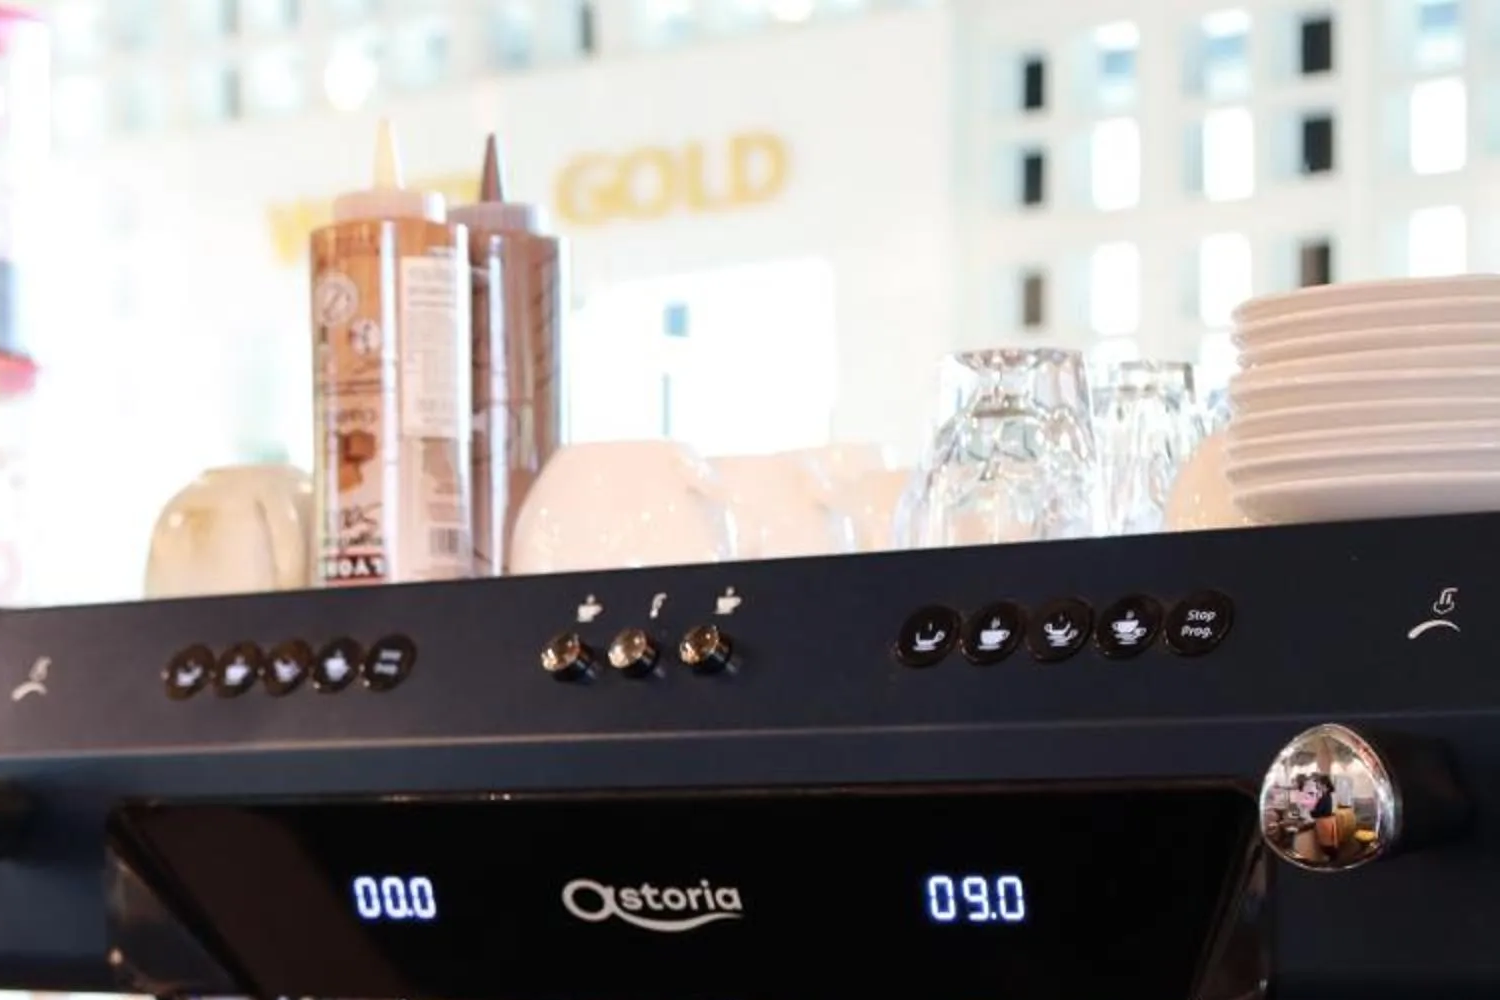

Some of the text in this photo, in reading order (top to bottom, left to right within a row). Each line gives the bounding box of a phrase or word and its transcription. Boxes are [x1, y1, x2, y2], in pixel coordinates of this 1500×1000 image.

[554, 131, 790, 227] GOLD
[1186, 609, 1217, 623] Stop
[927, 875, 1026, 921] 09.0
